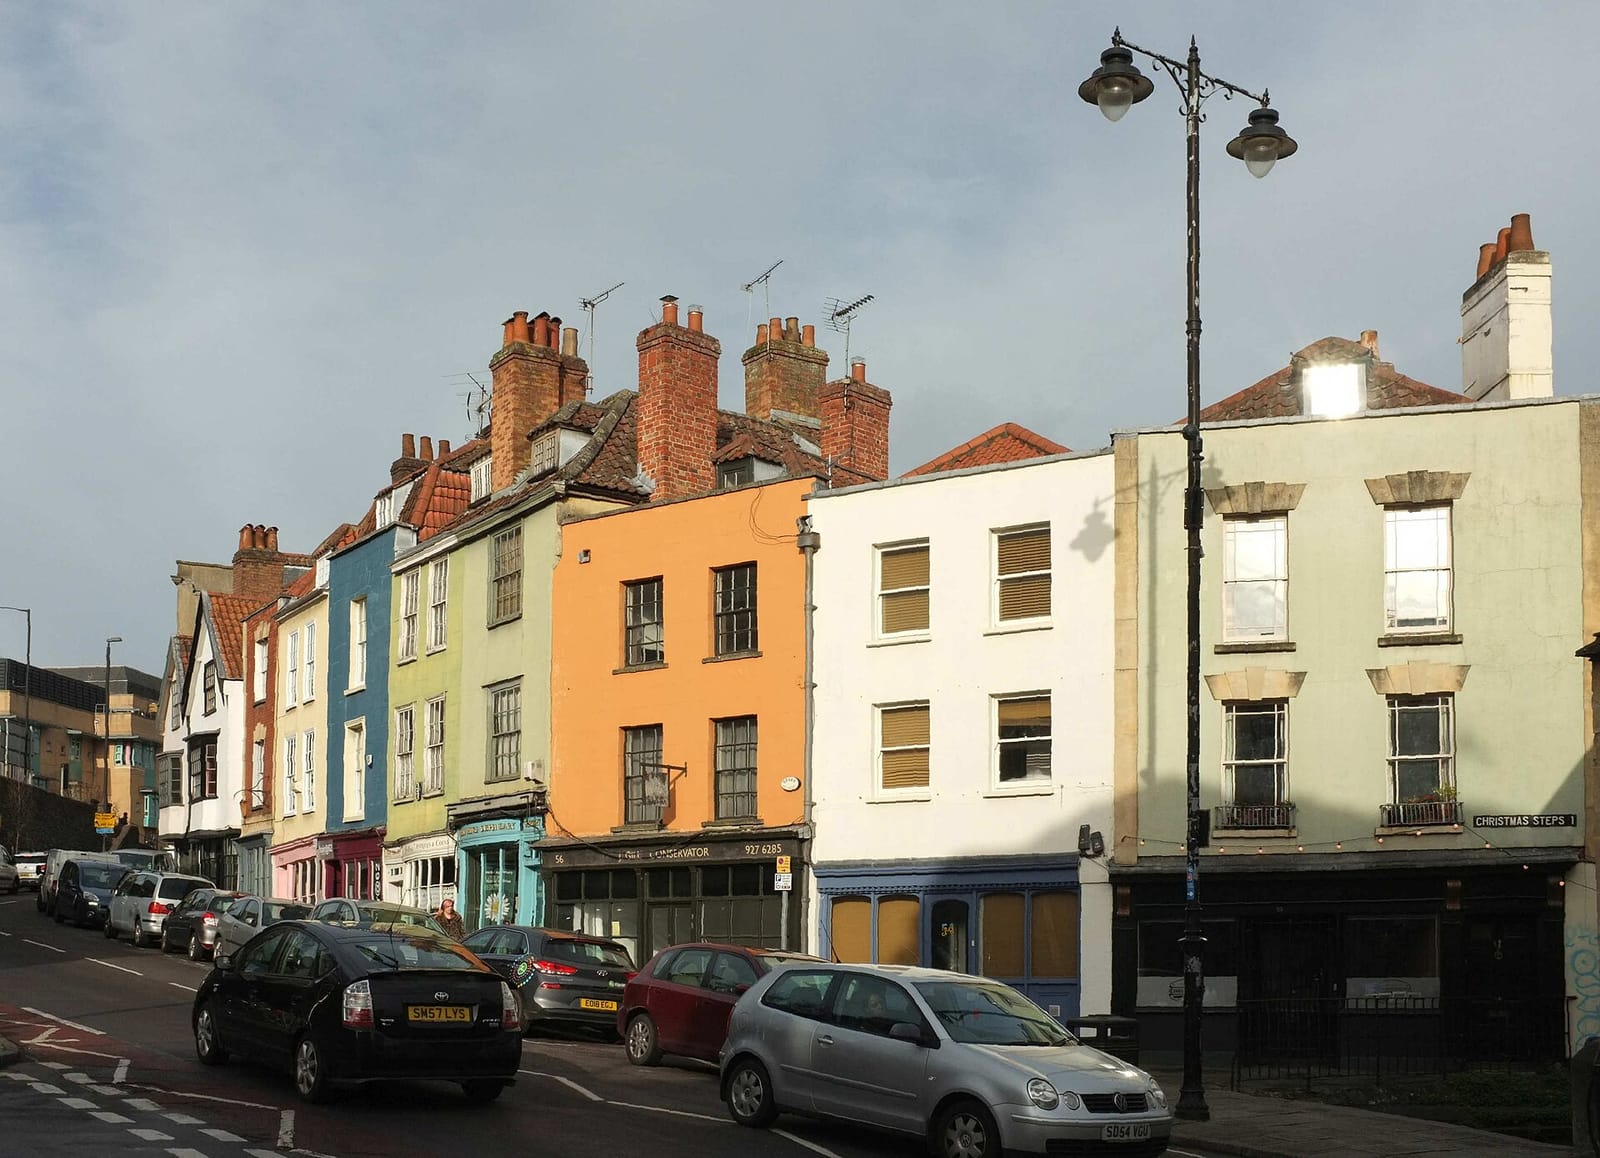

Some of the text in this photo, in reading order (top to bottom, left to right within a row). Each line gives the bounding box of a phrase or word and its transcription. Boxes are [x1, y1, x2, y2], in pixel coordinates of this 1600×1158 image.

[1475, 816, 1529, 826] CHRISTMAS
[1533, 815, 1565, 826] STEPS
[555, 854, 564, 864] 56
[745, 844, 760, 855] 927
[761, 843, 782, 854] 6285
[413, 1007, 465, 1019] SM57 LYS
